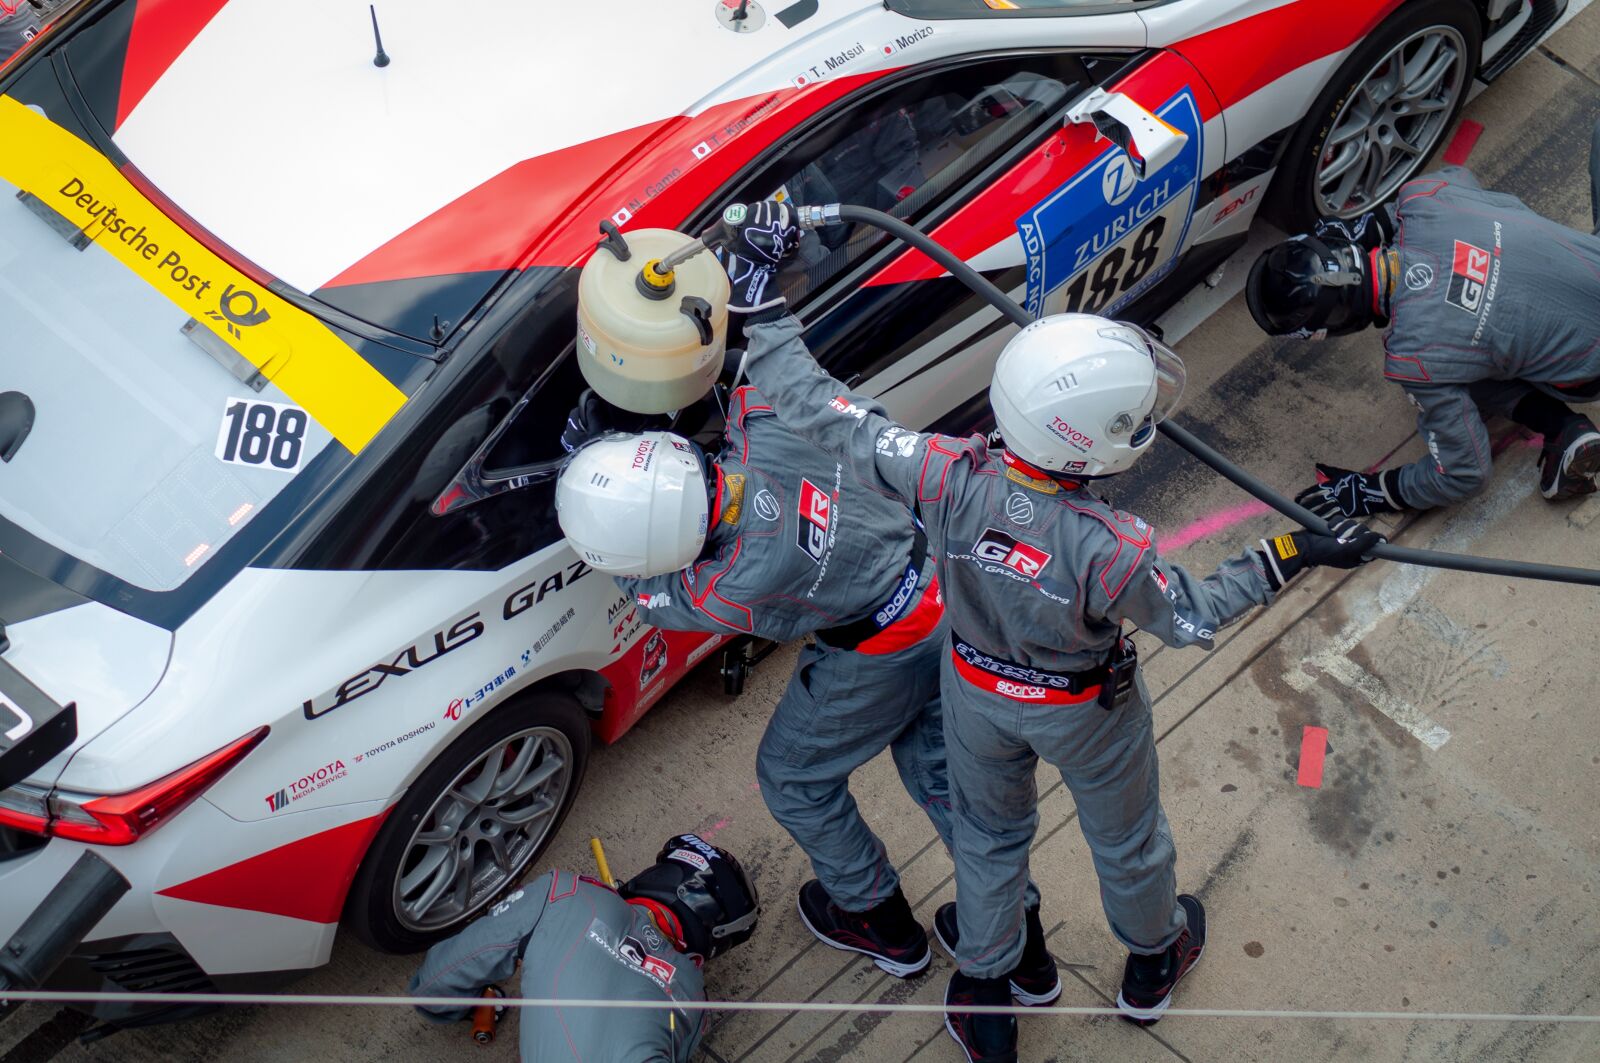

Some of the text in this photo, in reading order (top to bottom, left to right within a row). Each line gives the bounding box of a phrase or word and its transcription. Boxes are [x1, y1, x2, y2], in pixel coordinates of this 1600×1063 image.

[895, 25, 934, 51] Morizo
[809, 42, 865, 78] T. Matsui
[628, 167, 681, 213] N. Gamo
[59, 177, 211, 300] Deutsche Post
[1072, 178, 1169, 270] ZURICH
[1021, 223, 1041, 319] ADAC NO
[1065, 215, 1166, 313] 188
[1460, 248, 1488, 311] GR
[1470, 303, 1491, 347] TOYOTA
[1487, 258, 1501, 301] GAZOO
[223, 402, 308, 470] 188
[1052, 416, 1094, 449] TOYOTA
[632, 439, 651, 470] TOYOTA
[808, 490, 828, 560] GR
[807, 552, 831, 598] TOYOTA
[828, 503, 838, 549] GAZOO
[976, 541, 1039, 576] GR
[985, 565, 1030, 583] GAZOO
[876, 569, 918, 627] sparco
[302, 611, 485, 721] LEXUS
[956, 643, 1069, 688] alpinestars
[465, 666, 516, 708] トヨタ車体
[996, 680, 1046, 698] sparco
[364, 721, 436, 759] TOYOTA BOSHOKU
[289, 759, 346, 793] TOYOTA
[292, 769, 348, 802] MEDIA SERVICE
[677, 851, 705, 865] TOYOTA
[680, 834, 721, 860] uvex
[590, 930, 627, 965] TOYOTA
